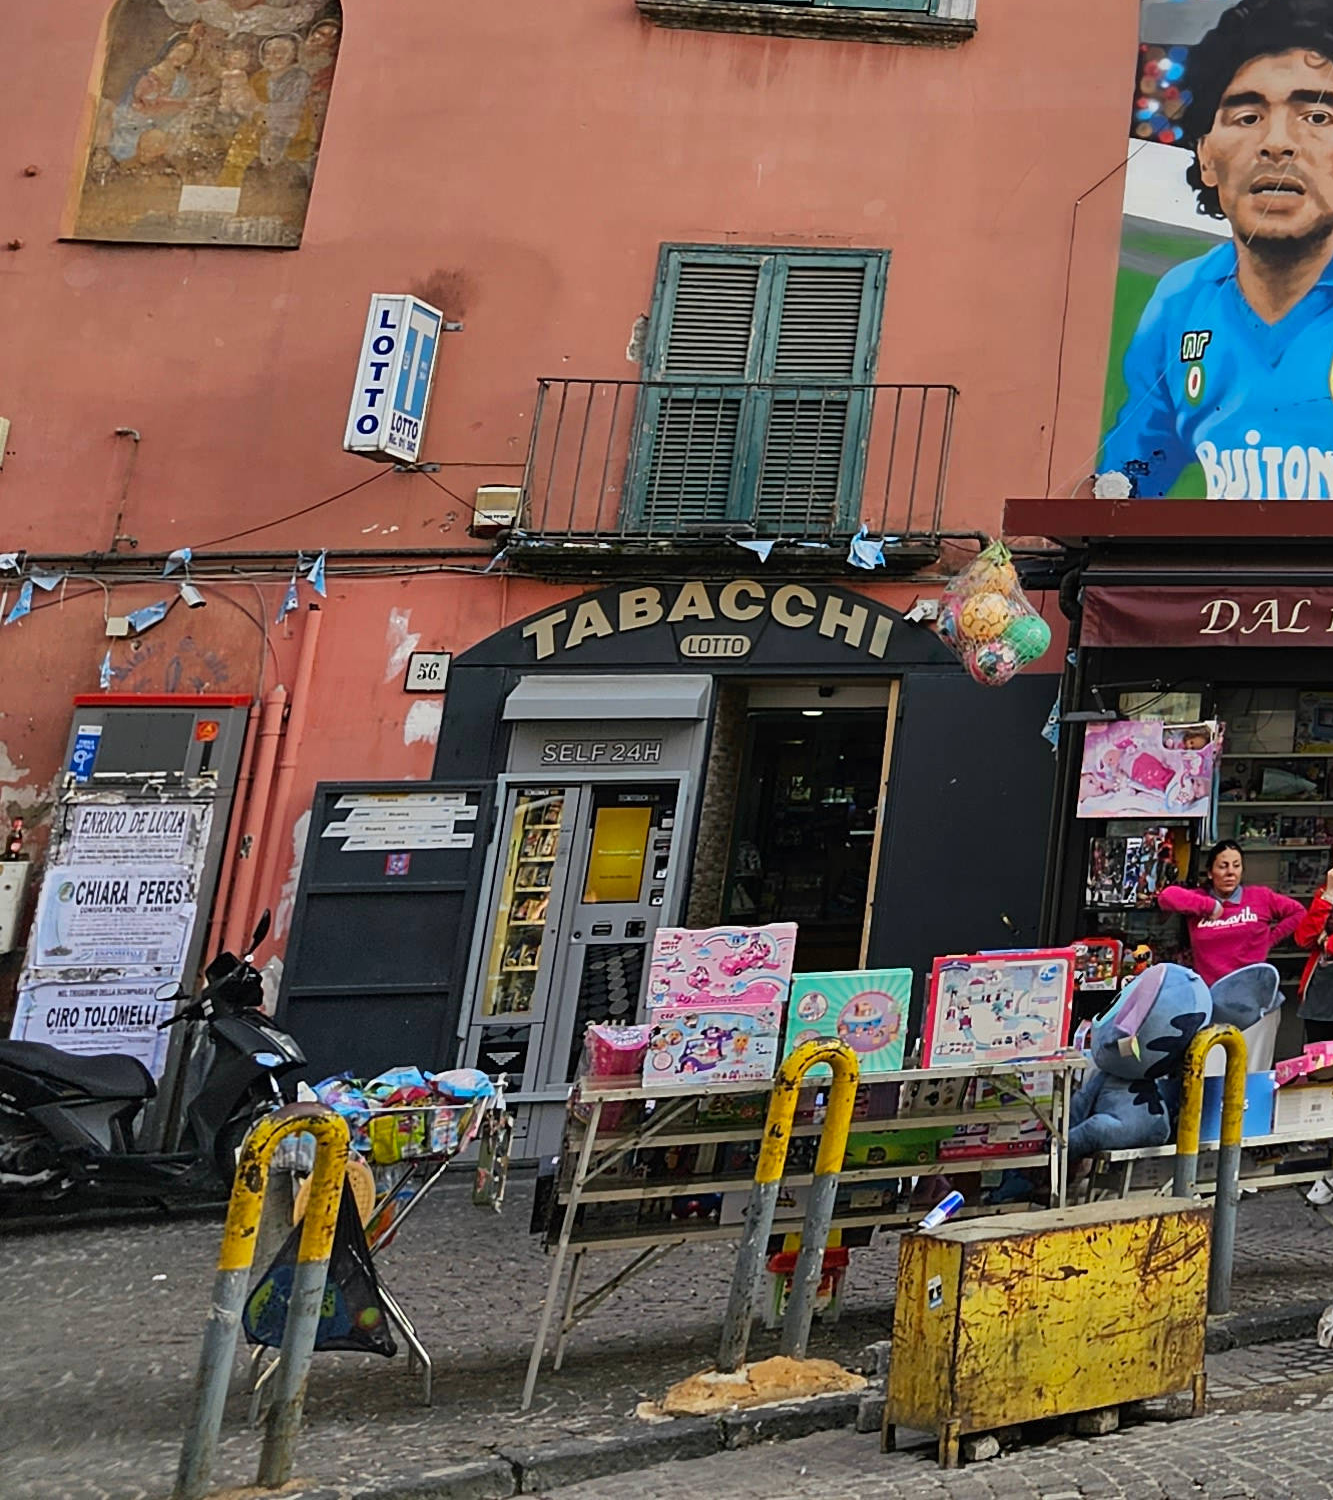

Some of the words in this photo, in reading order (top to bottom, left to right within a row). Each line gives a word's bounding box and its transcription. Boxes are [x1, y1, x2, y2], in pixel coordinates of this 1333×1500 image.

[357, 309, 397, 435] LOTTO
[391, 411, 419, 440] LOTTO
[523, 579, 894, 660] TABACCHI
[1199, 599, 1311, 635] DAL
[687, 636, 745, 655] LOTTO
[542, 743, 607, 762] SELF
[610, 741, 662, 762] 24H
[80, 811, 128, 834] ENRICO
[128, 811, 145, 834] DE
[147, 810, 186, 834] LUCIA
[75, 881, 130, 906] CHIARA
[136, 880, 185, 905] PERES
[46, 1006, 80, 1028] CIRO
[84, 1004, 159, 1027] TOLOMELLI
